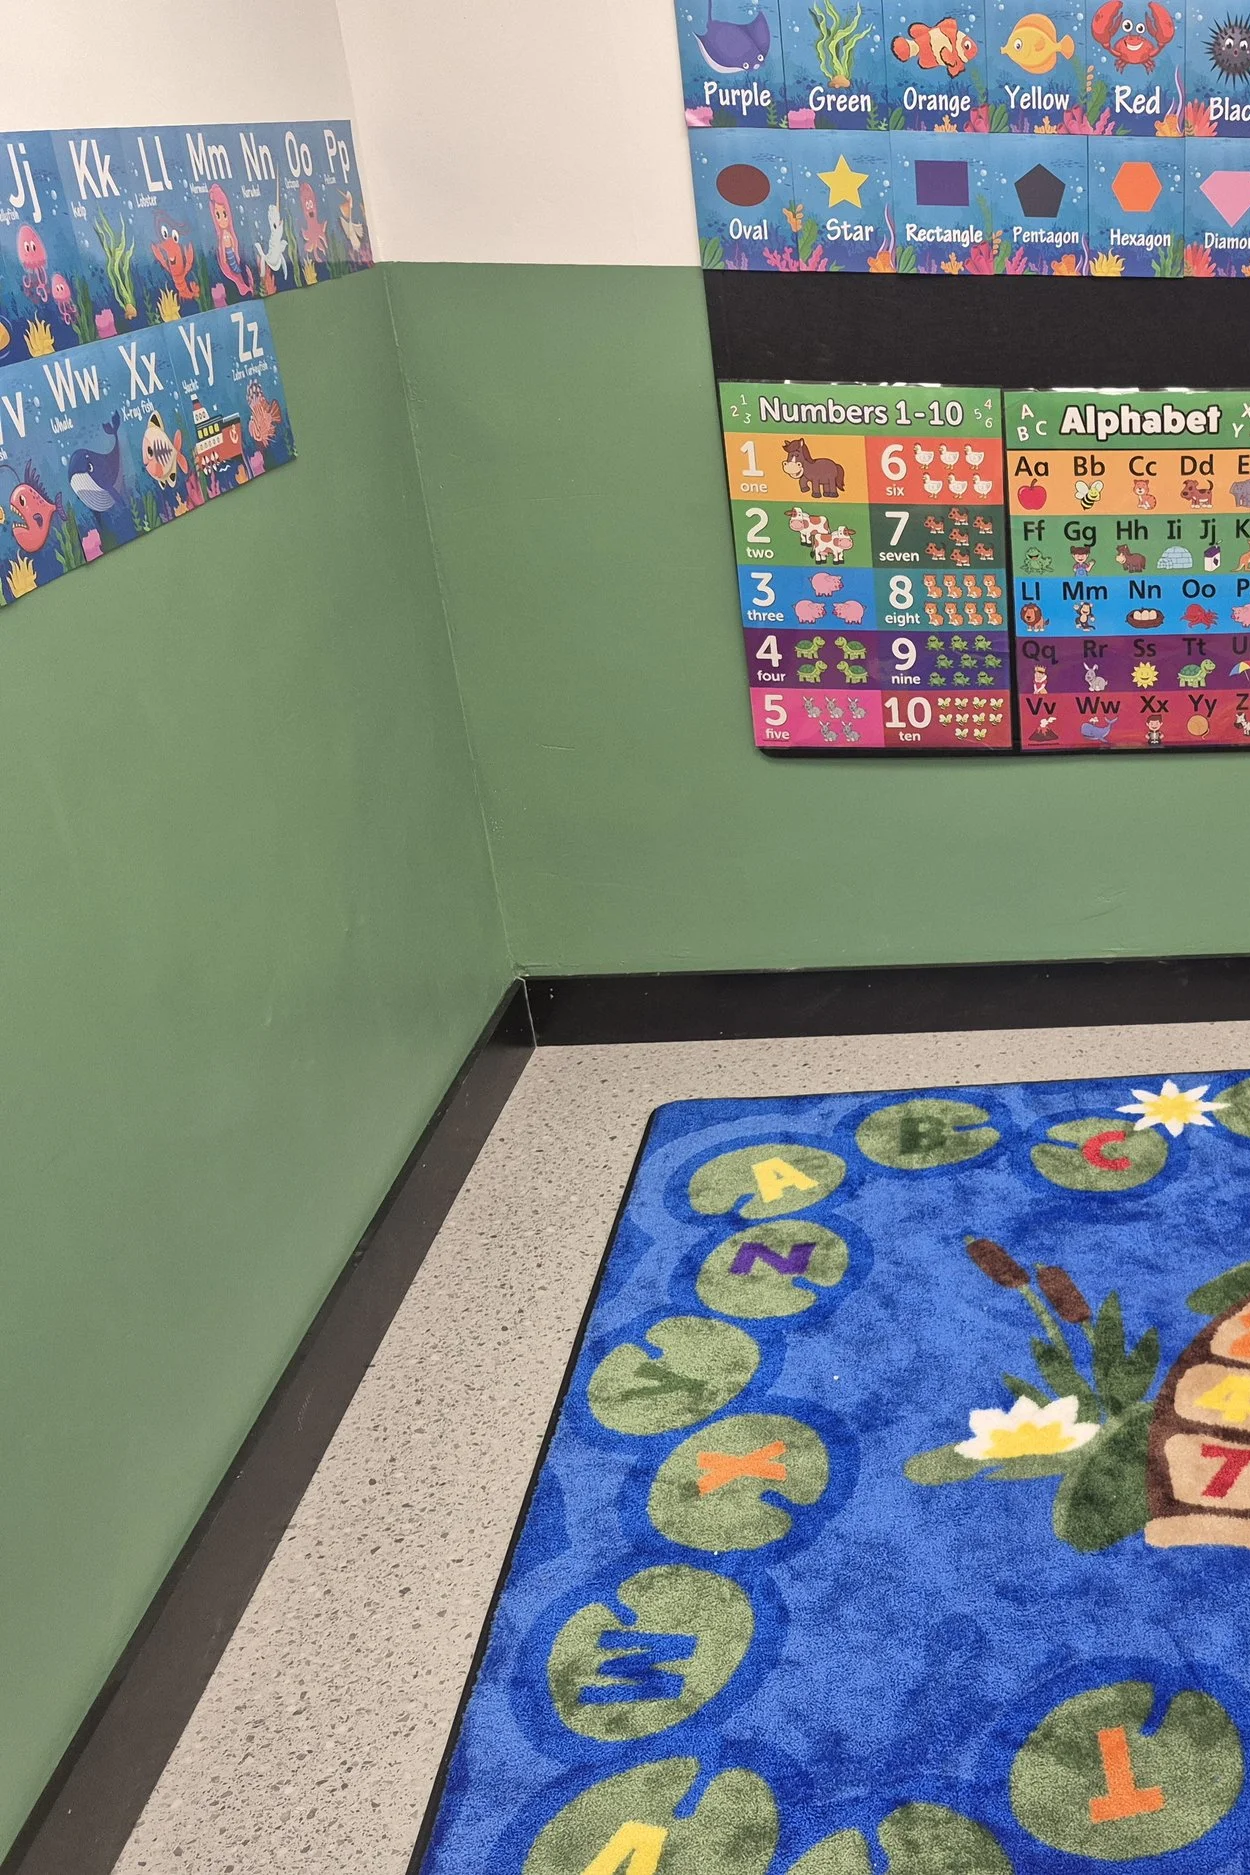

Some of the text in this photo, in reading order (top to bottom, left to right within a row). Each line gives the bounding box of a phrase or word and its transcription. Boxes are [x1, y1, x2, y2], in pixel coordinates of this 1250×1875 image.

[703, 81, 772, 115] Purple
[809, 87, 872, 112] Green
[903, 87, 971, 117] Orange
[1004, 86, 1069, 110] Yellow
[1115, 85, 1160, 114] Red
[137, 136, 172, 192] Ll
[186, 133, 232, 181] Mm
[240, 133, 275, 181] Nn
[285, 131, 313, 178] Oo
[324, 129, 349, 183] Pp
[7, 143, 41, 223] Jj
[69, 140, 120, 200] Kk
[729, 218, 769, 241] Oval
[826, 219, 874, 241] Star
[906, 223, 983, 244] Rectangle
[1013, 226, 1078, 246] Pentagon
[1110, 228, 1171, 250] Hexagon
[230, 312, 264, 362] Zz
[178, 322, 214, 386] Yy
[118, 342, 164, 400] Xx
[42, 358, 100, 412] Ww
[141, 398, 154, 413] fish
[730, 406, 739, 417] 2
[739, 394, 747, 405] 1
[759, 396, 963, 426] Numbers 1-10
[984, 399, 992, 410] 4
[1021, 404, 1034, 419] A
[743, 412, 751, 424] 3
[974, 408, 982, 420] 5
[985, 417, 993, 428] 6
[1059, 404, 1221, 442] Alphabet
[1017, 426, 1030, 442] B
[1036, 420, 1047, 436] C
[1232, 423, 1244, 438] Y
[739, 441, 764, 477] 1
[881, 444, 907, 481] 6
[1014, 456, 1049, 477] Aa
[1073, 455, 1105, 477] Bb
[1128, 455, 1157, 477] Cc
[1180, 454, 1214, 476] Dd
[740, 482, 768, 494] one
[886, 484, 905, 497] six
[745, 507, 771, 544] 2
[885, 511, 910, 547] 7
[1023, 520, 1045, 542] Ff
[1064, 521, 1097, 547] Gg
[1116, 520, 1148, 540] Hh
[1167, 519, 1182, 540] Ii
[1199, 519, 1216, 546] Jj
[746, 547, 774, 559] two
[879, 551, 920, 562] seven
[750, 572, 776, 607] 3
[888, 575, 914, 610] 8
[1021, 581, 1040, 601] Ll
[1062, 581, 1108, 601] Mm
[1129, 579, 1162, 600] Nn
[1182, 578, 1216, 599] Oo
[747, 609, 784, 622] three
[885, 613, 920, 627] eight
[755, 635, 783, 668] 4
[891, 637, 917, 671] 9
[1022, 640, 1059, 665] Qq
[1084, 639, 1108, 658] Rr
[1133, 638, 1157, 658] Ss
[1182, 638, 1206, 656] Tt
[756, 670, 786, 683] four
[891, 673, 921, 685] nine
[764, 694, 788, 727] 5
[885, 697, 932, 728] 10
[1026, 698, 1056, 716] Vv
[1076, 697, 1120, 714] Ww
[1140, 695, 1170, 714] Xx
[1188, 694, 1217, 717] Yy
[765, 727, 790, 740] five
[899, 731, 921, 742] ten
[1082, 1131, 1131, 1170] C
[752, 1157, 820, 1203] A
[697, 1440, 787, 1495] X
[1089, 1726, 1164, 1824] T
